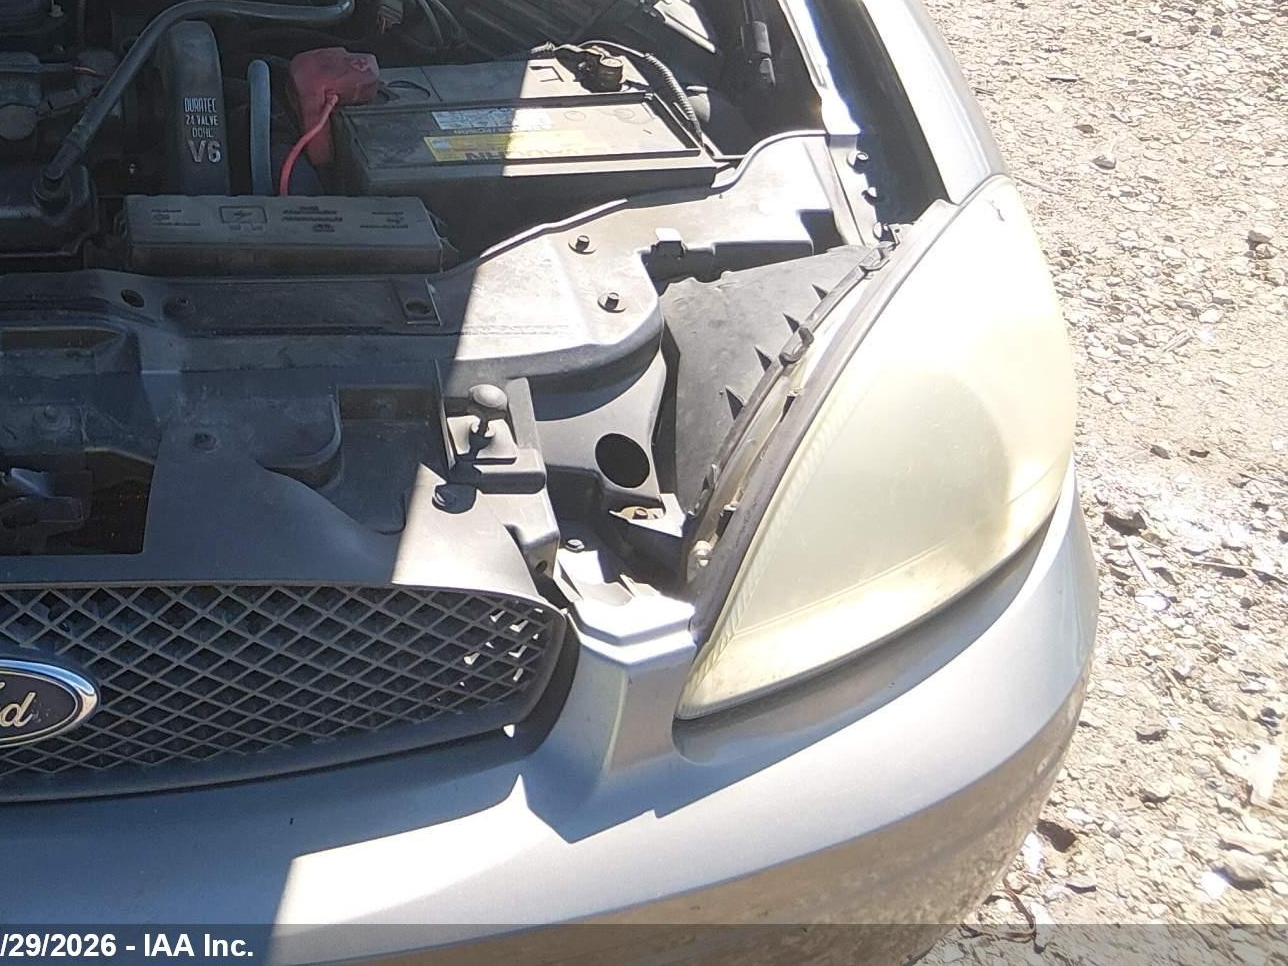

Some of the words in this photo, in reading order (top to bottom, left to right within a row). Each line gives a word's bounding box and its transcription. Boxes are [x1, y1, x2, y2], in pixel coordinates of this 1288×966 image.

[184, 97, 217, 113] DURATEC
[185, 115, 195, 126] 24
[196, 115, 219, 126] VALVE
[187, 140, 221, 163] V6
